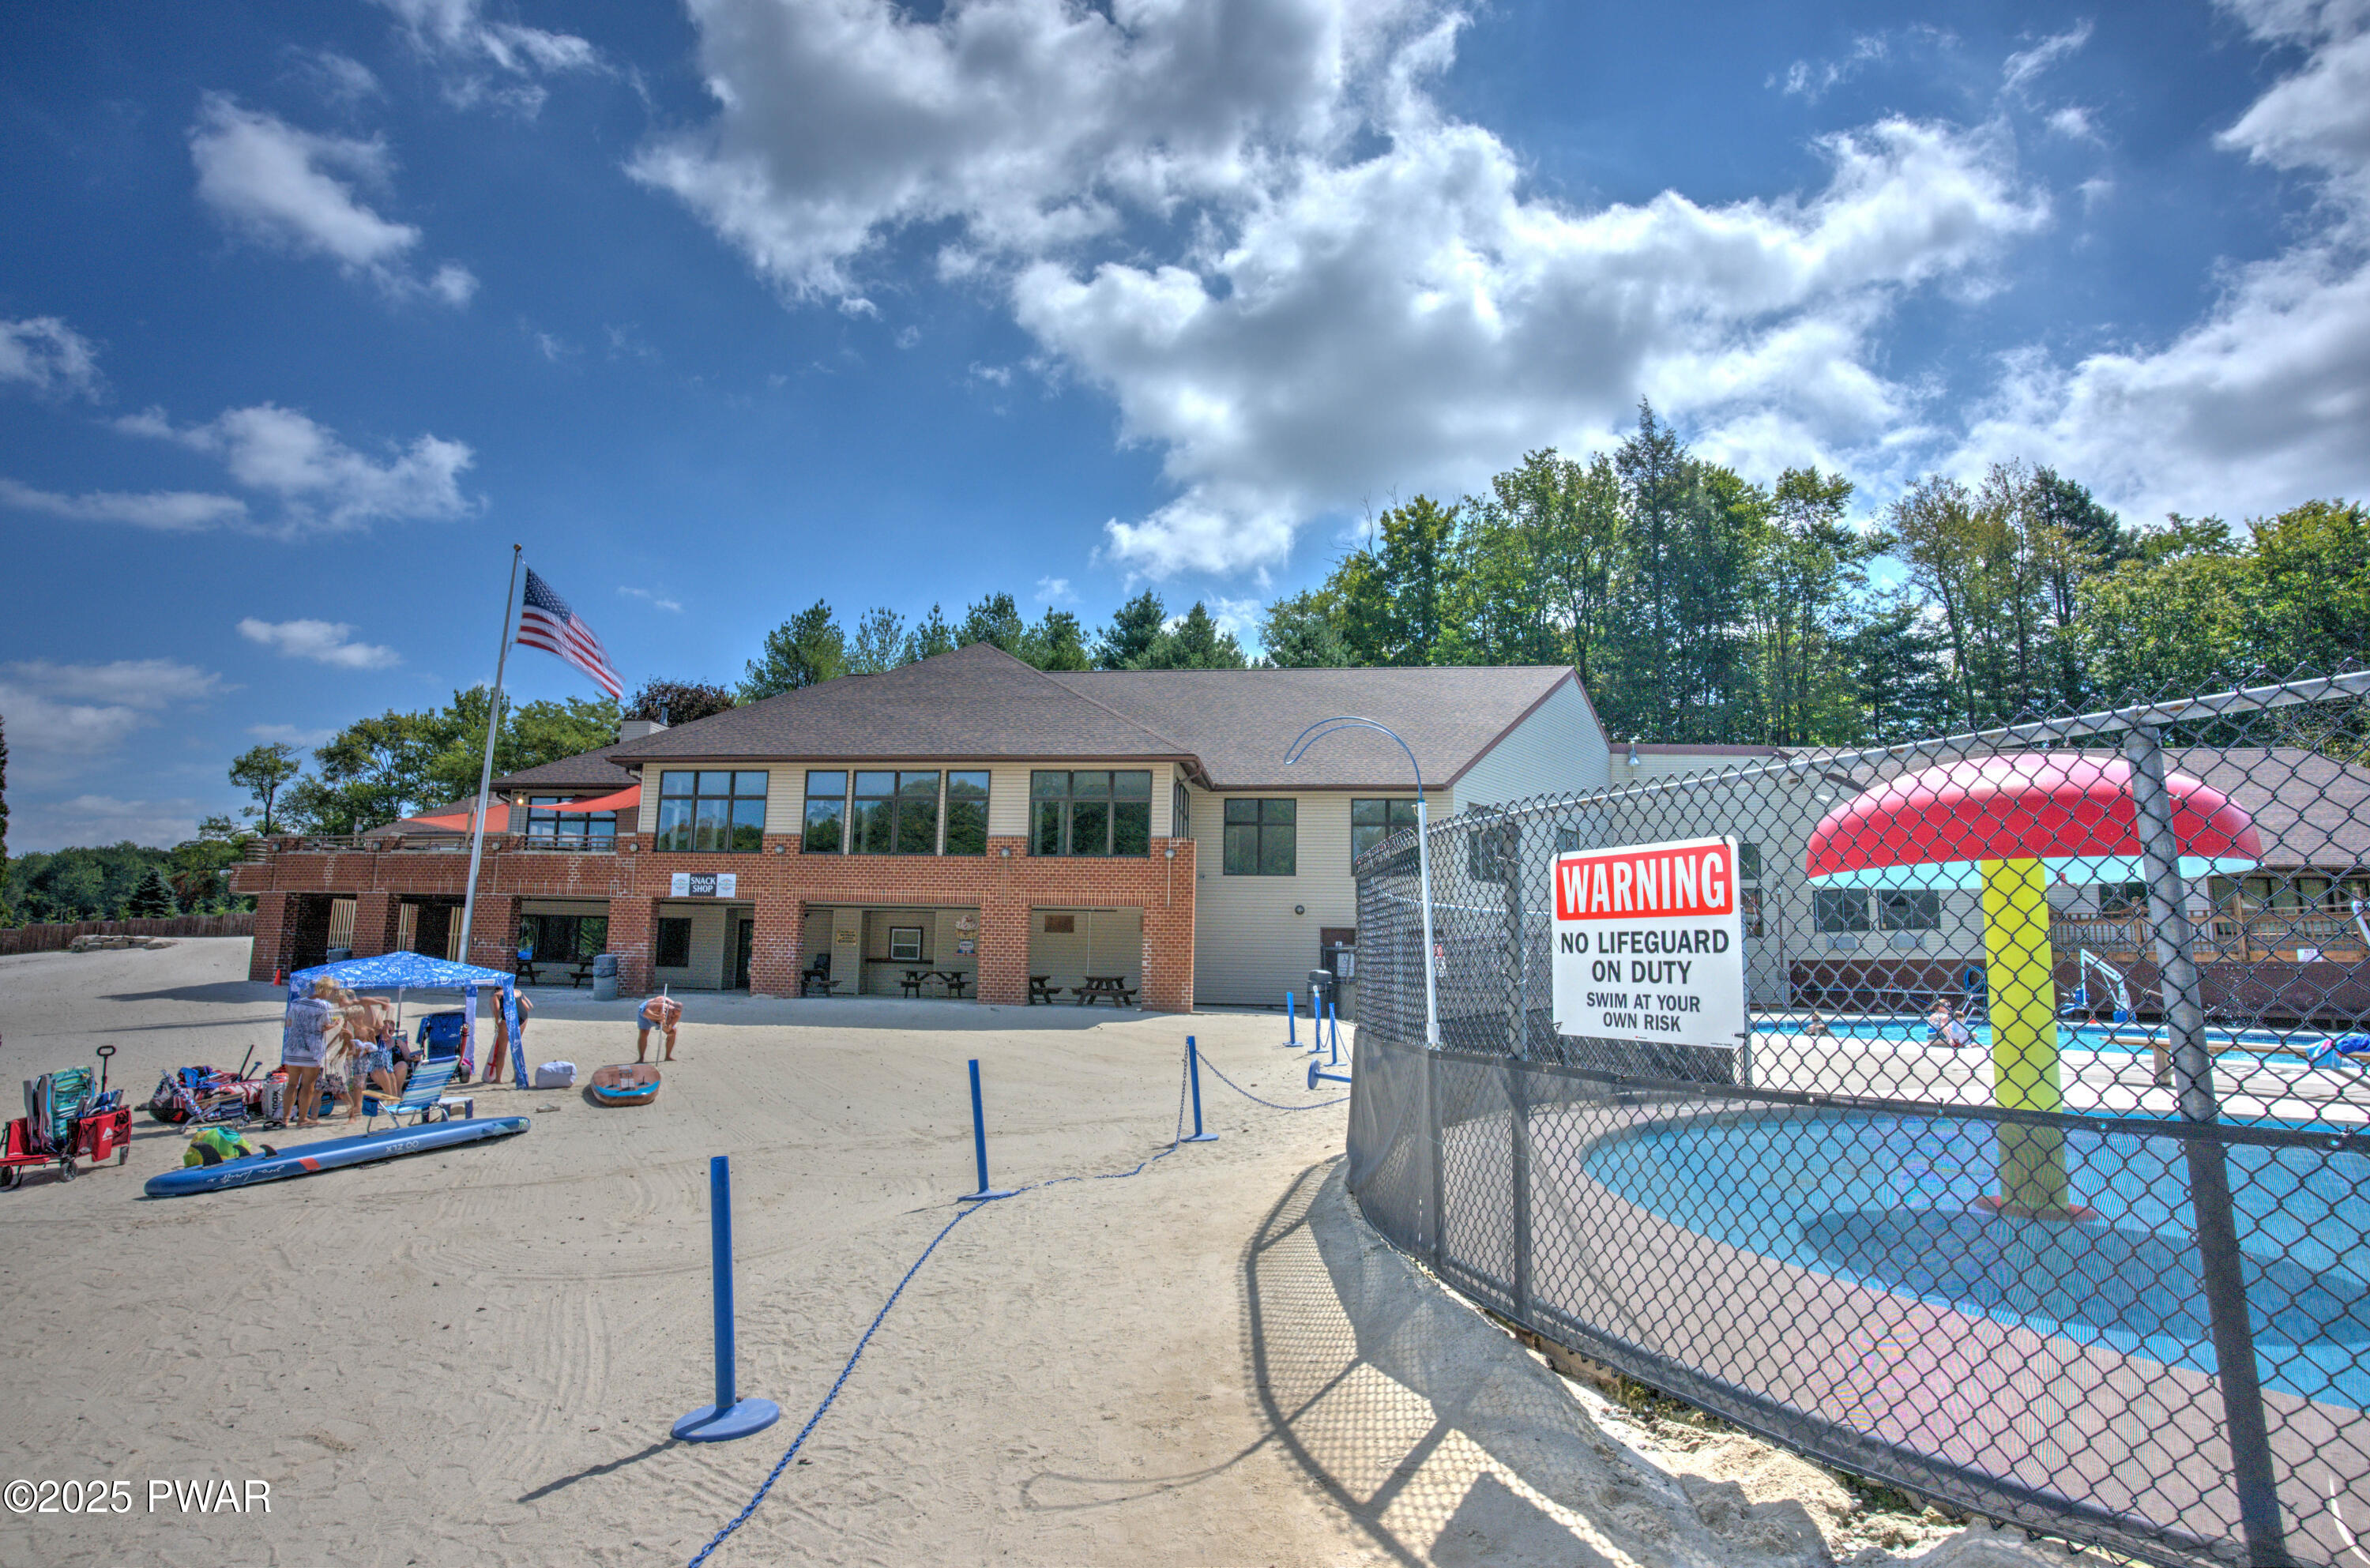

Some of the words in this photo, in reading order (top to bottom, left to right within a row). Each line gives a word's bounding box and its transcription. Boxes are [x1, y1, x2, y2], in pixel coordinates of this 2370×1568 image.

[1561, 852, 1726, 914] WARNING
[1560, 932, 1589, 954] NO
[1598, 929, 1729, 954] LIFEGUARD
[1592, 960, 1621, 983] ON
[1631, 960, 1692, 984] DUTY
[1586, 992, 1627, 1009] SWIM
[1634, 994, 1651, 1010] AT
[1657, 995, 1700, 1013] YOUR
[1603, 1012, 1638, 1028] OWN
[1644, 1013, 1681, 1032] RISK
